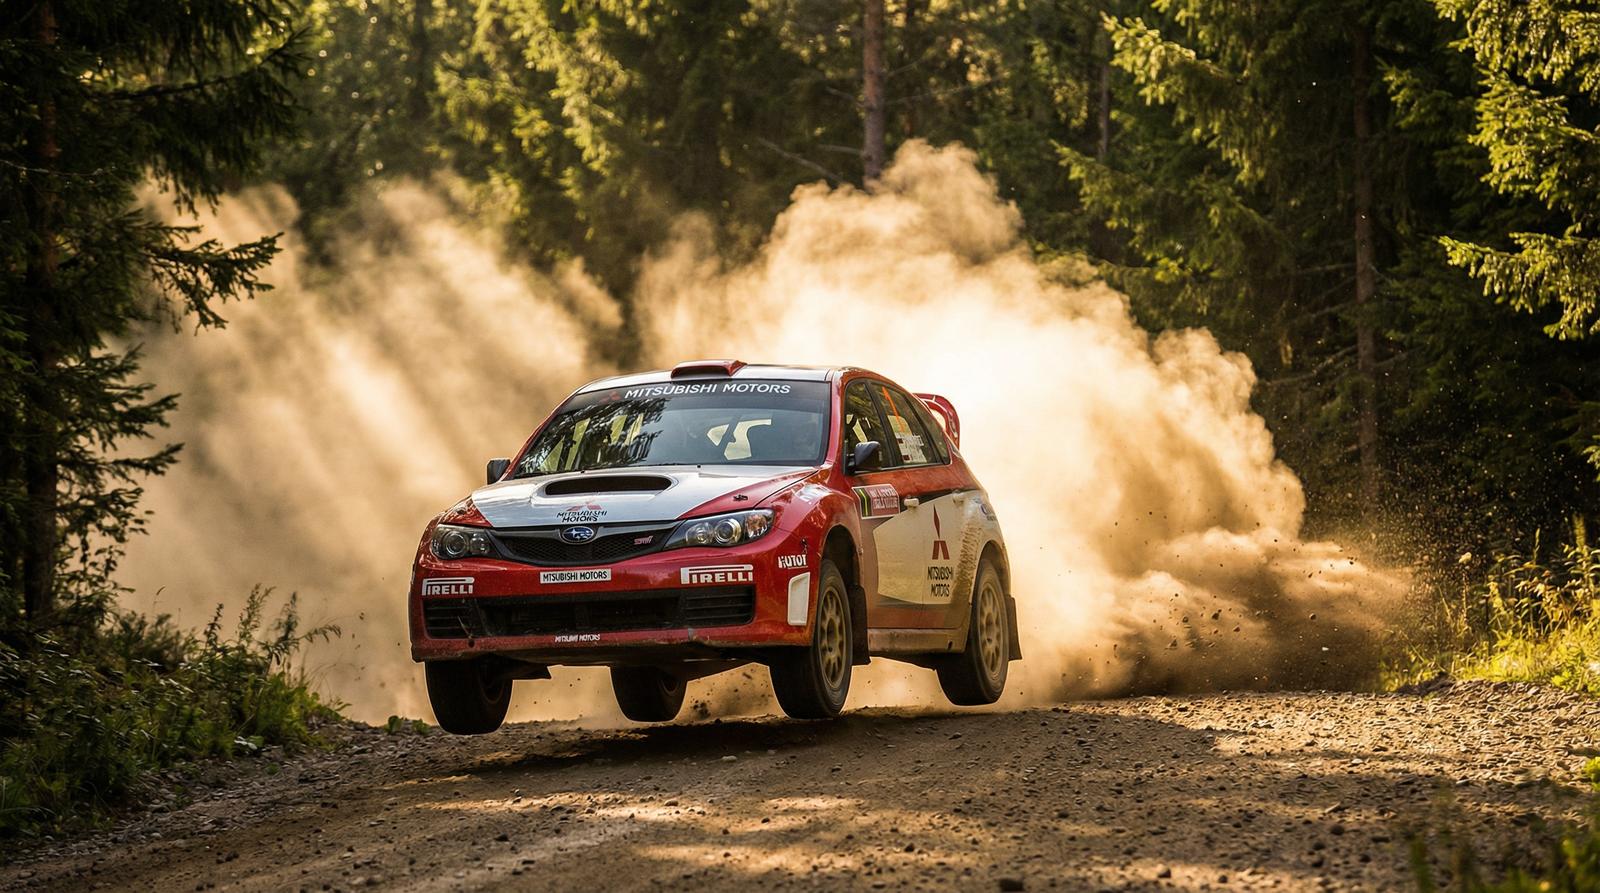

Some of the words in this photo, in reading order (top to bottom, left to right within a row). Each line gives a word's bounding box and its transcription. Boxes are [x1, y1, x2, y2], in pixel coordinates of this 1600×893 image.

[624, 383, 718, 399] MITSUBISHI
[722, 383, 792, 394] MOTORS
[580, 570, 608, 580] MOTORS
[680, 564, 754, 584] PIRELLI
[421, 576, 475, 596] PIRELLI
